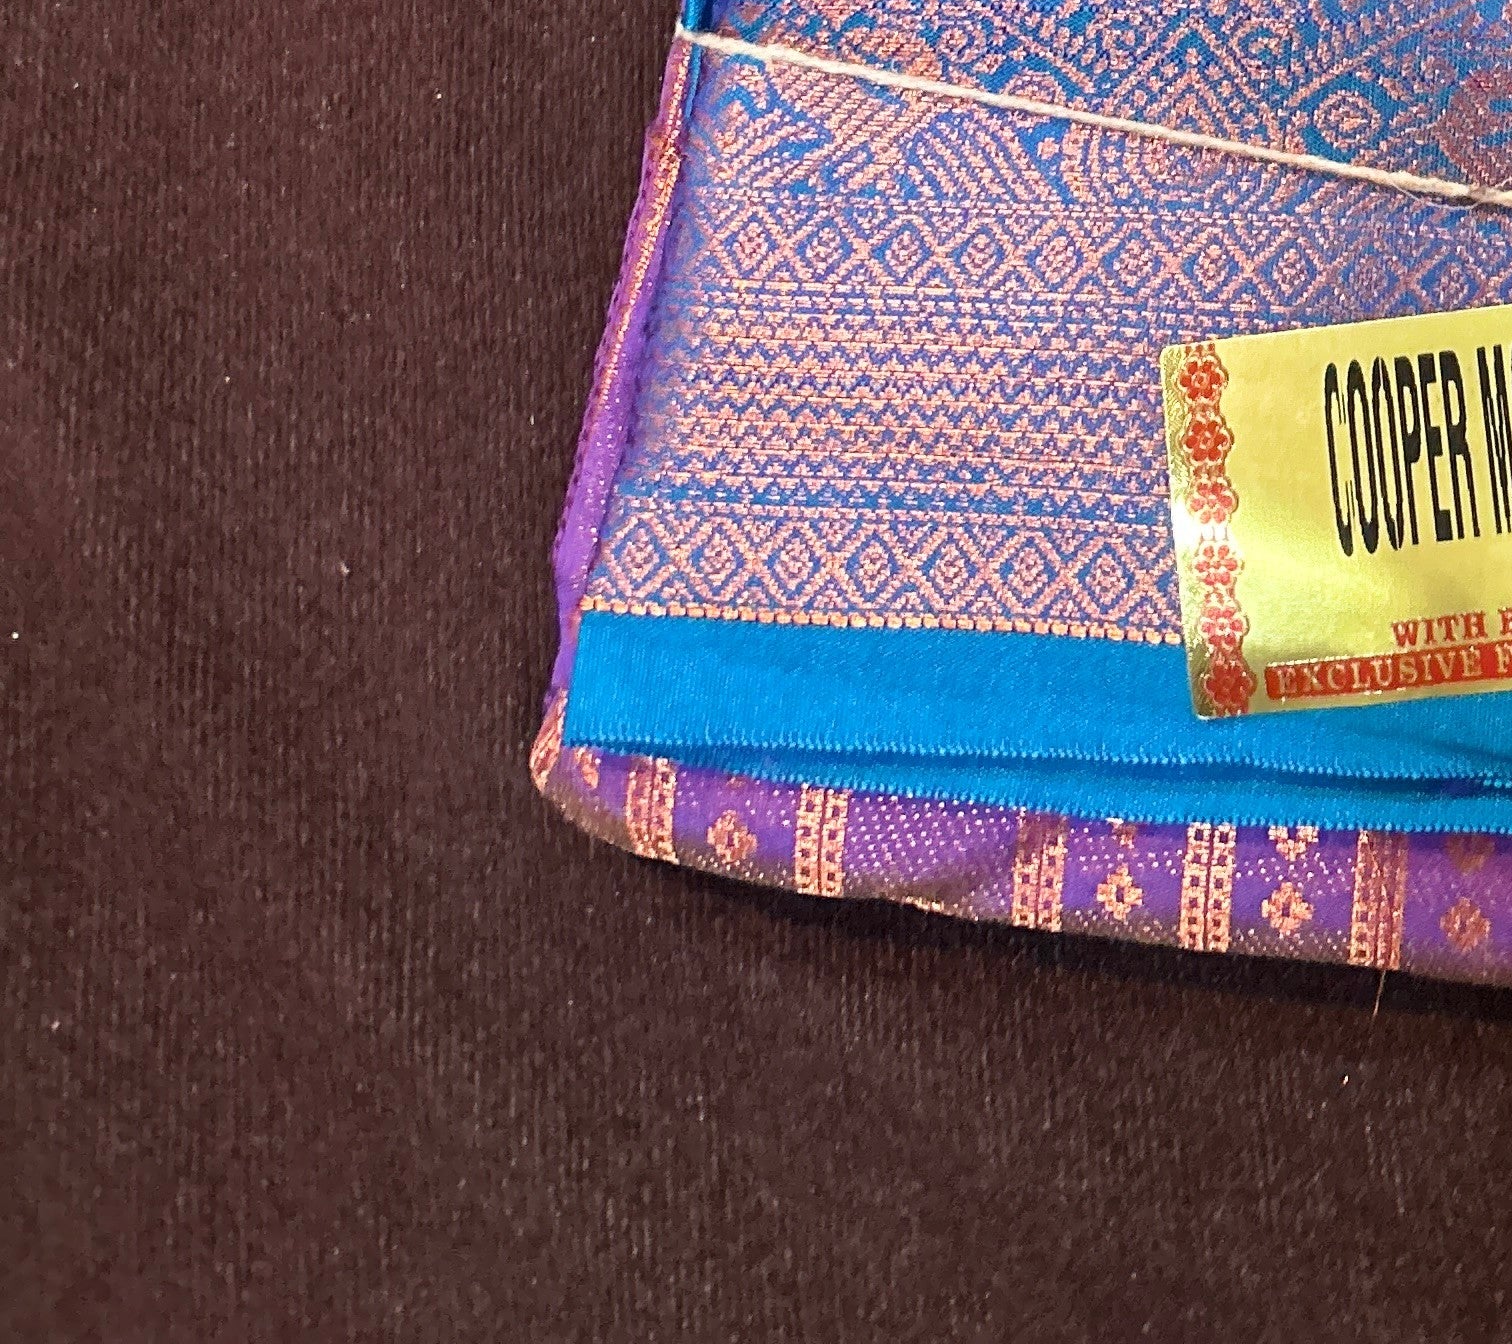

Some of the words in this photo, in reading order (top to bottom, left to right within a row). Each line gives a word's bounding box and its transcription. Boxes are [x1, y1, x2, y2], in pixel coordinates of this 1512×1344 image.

[1324, 349, 1482, 557] COOPER
[1391, 616, 1489, 649] WITH
[1275, 647, 1485, 696] EXCLUSIVE
